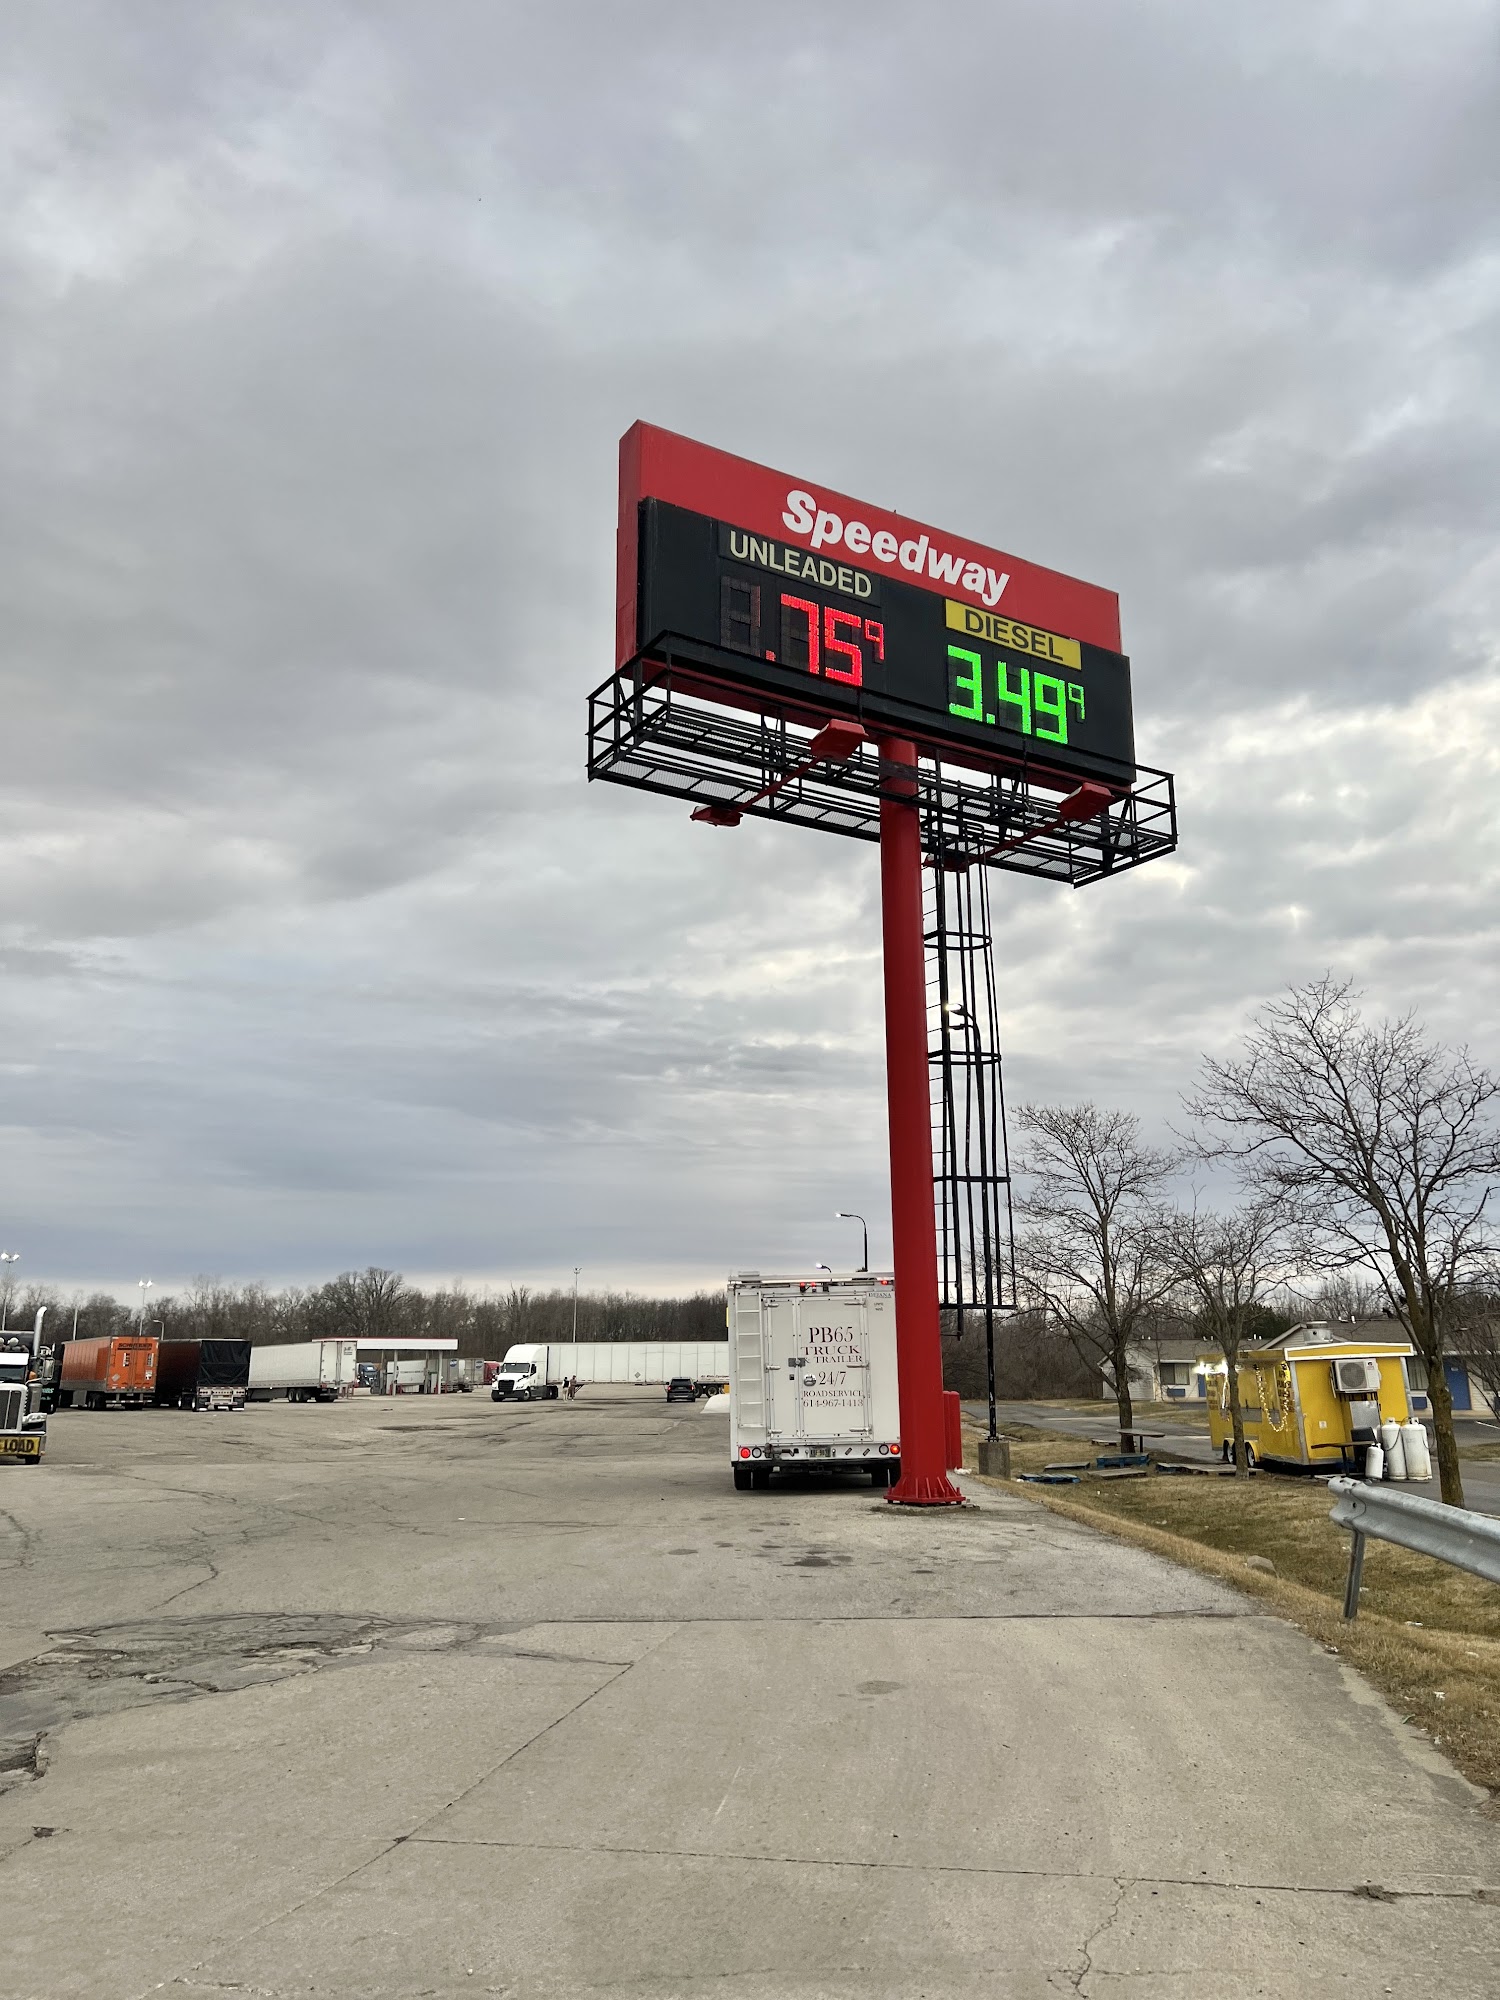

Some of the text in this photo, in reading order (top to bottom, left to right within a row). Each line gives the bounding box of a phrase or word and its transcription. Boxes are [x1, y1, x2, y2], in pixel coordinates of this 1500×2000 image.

[782, 490, 1010, 606] Speedway
[730, 530, 872, 598] UNLEADED
[965, 609, 1064, 661] DIESEL
[809, 1326, 854, 1343] PB65
[800, 1345, 860, 1356] TRUCK
[813, 1355, 864, 1364] TRAILER
[818, 1371, 847, 1387] 24/7
